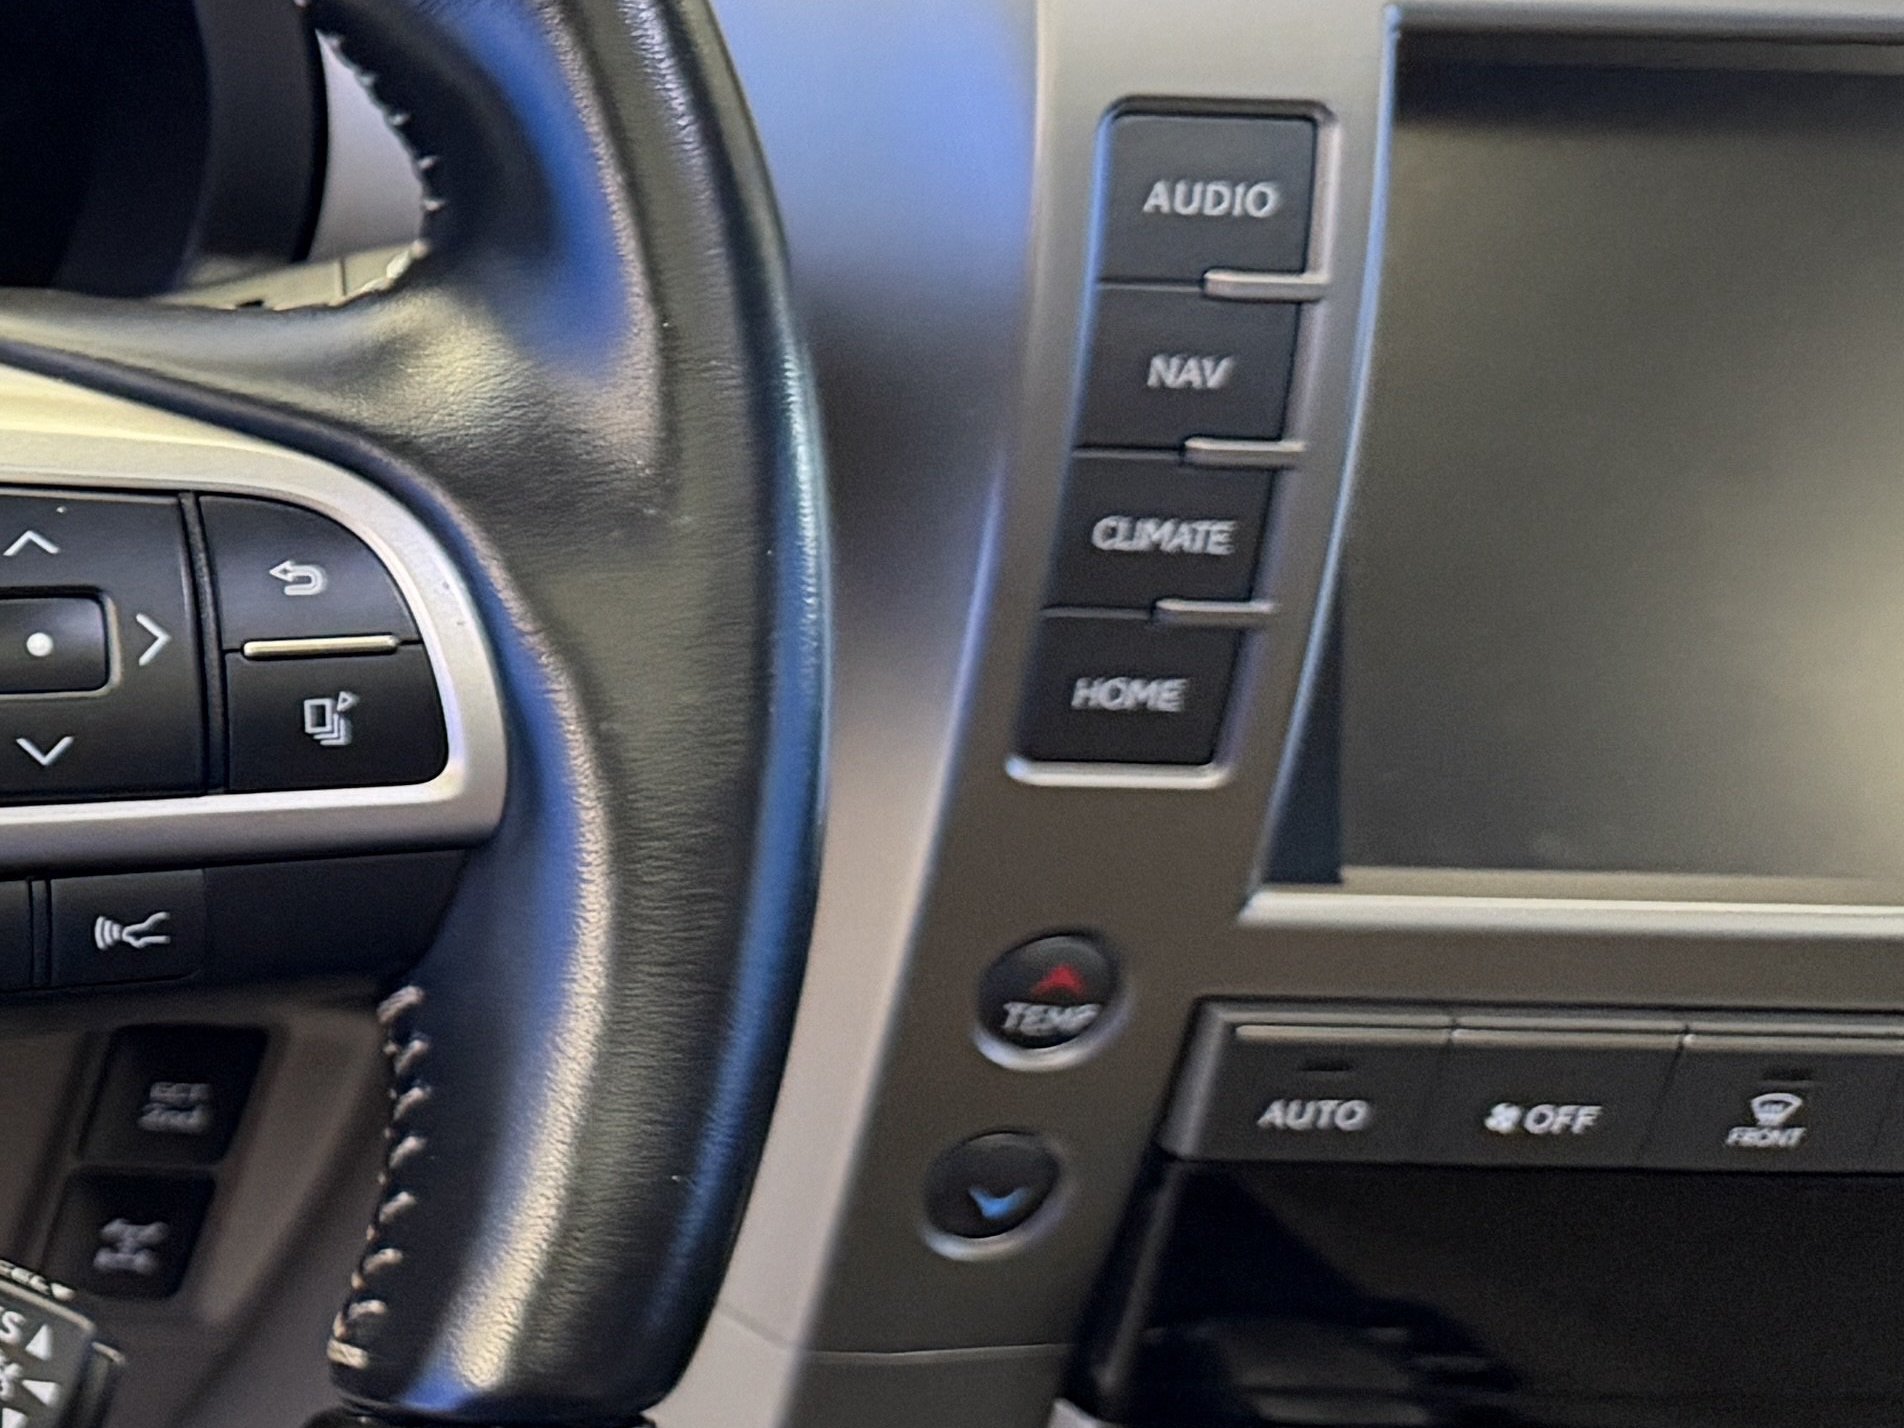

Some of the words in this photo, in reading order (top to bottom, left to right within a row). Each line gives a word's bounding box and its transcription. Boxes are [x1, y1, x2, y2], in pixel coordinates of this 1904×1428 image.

[1144, 180, 1281, 218] AUDIO
[1147, 354, 1235, 389] NAV
[1092, 515, 1236, 556] CLIMATE
[1071, 677, 1189, 713] HOME
[1002, 1001, 1101, 1036] TEMP
[1256, 1099, 1372, 1132] AUTO
[1524, 1104, 1603, 1135] OFF
